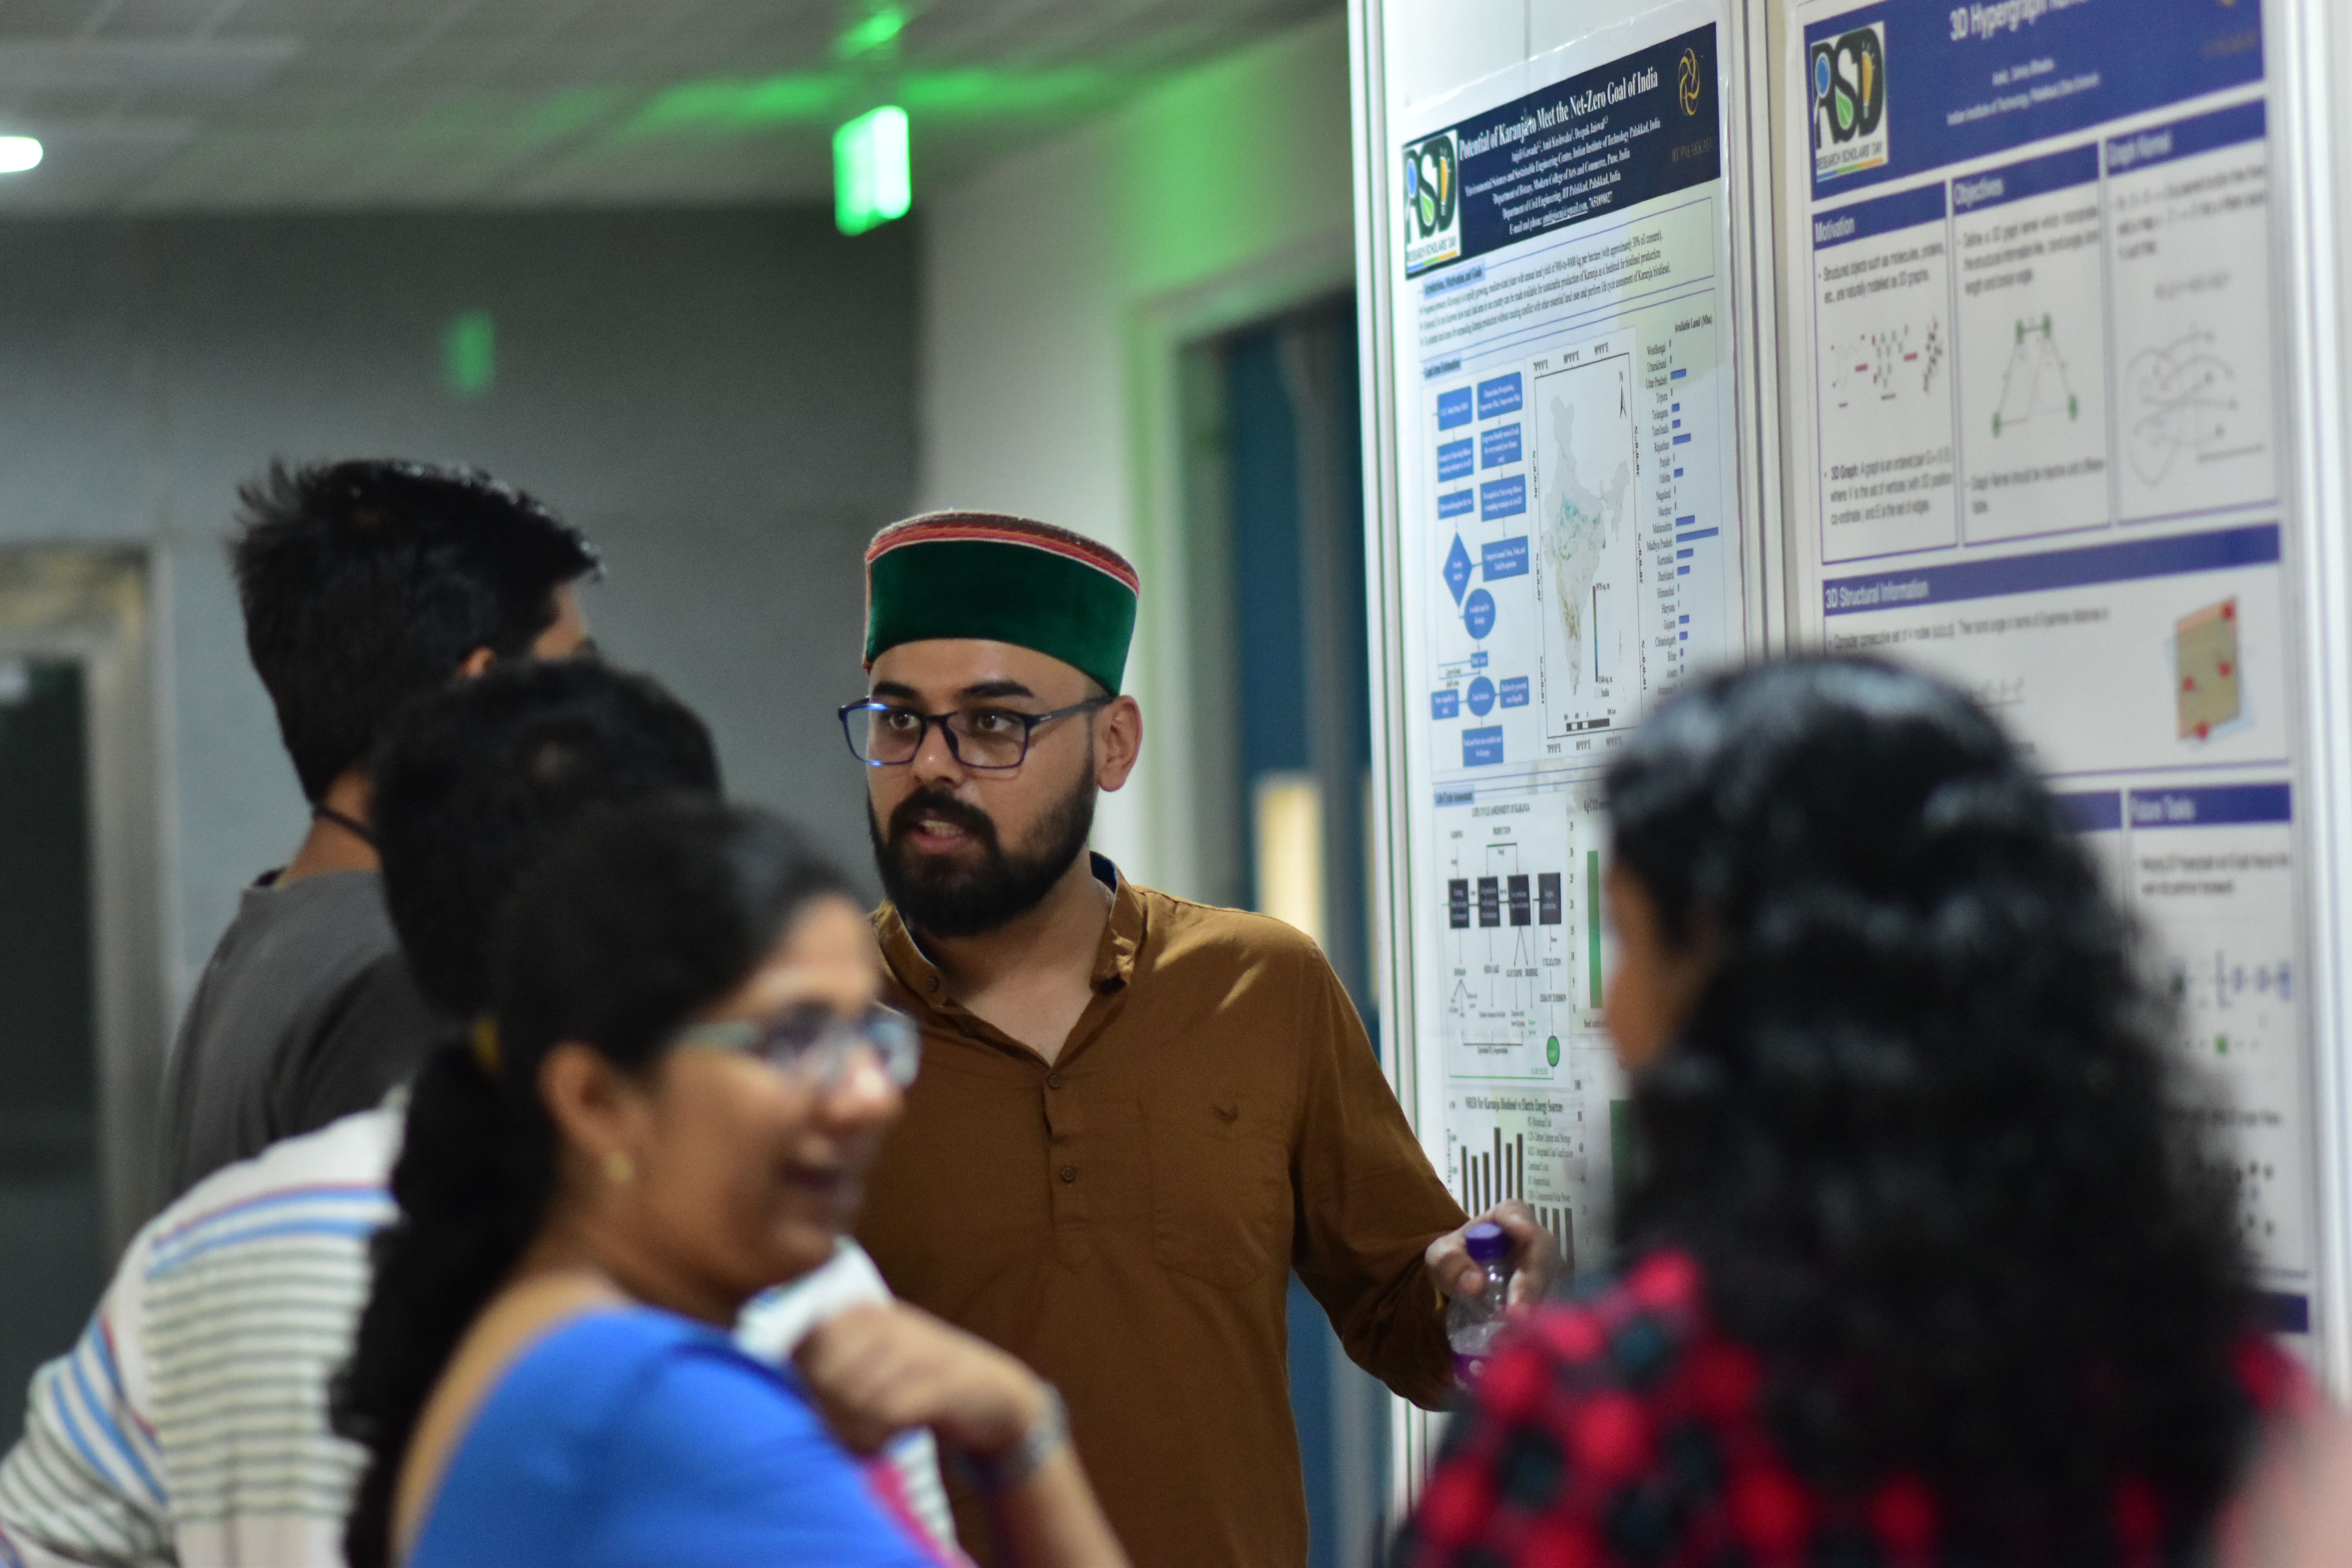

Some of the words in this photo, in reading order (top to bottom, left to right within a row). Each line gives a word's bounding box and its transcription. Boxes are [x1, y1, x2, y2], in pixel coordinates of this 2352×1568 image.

[1950, 7, 1968, 40] 3D
[1460, 129, 1489, 160] Potential
[1491, 125, 1498, 149] of
[1537, 106, 1555, 131] Meet
[1556, 98, 1568, 123] the
[1570, 90, 1606, 118] Net-Zero
[1607, 76, 1626, 105] Goal
[1628, 72, 1636, 97] of
[1637, 65, 1658, 94] India
[1650, 117, 1660, 131] India
[1955, 178, 2004, 207] Objectives
[1815, 215, 1855, 242] Motivation
[1674, 319, 1690, 332] Available
[1691, 317, 1700, 328] Land
[1701, 314, 1712, 328] (Mha)
[1654, 441, 1669, 454] Rajasthan
[1659, 456, 1670, 469] Punjab
[1659, 472, 1670, 483] Odisha
[1660, 537, 1672, 549] Pradesh
[1825, 588, 1837, 609] 3D
[1840, 582, 1878, 608] Structural
[1662, 603, 1675, 615] Haryana
[1668, 651, 1677, 662] Bihar
